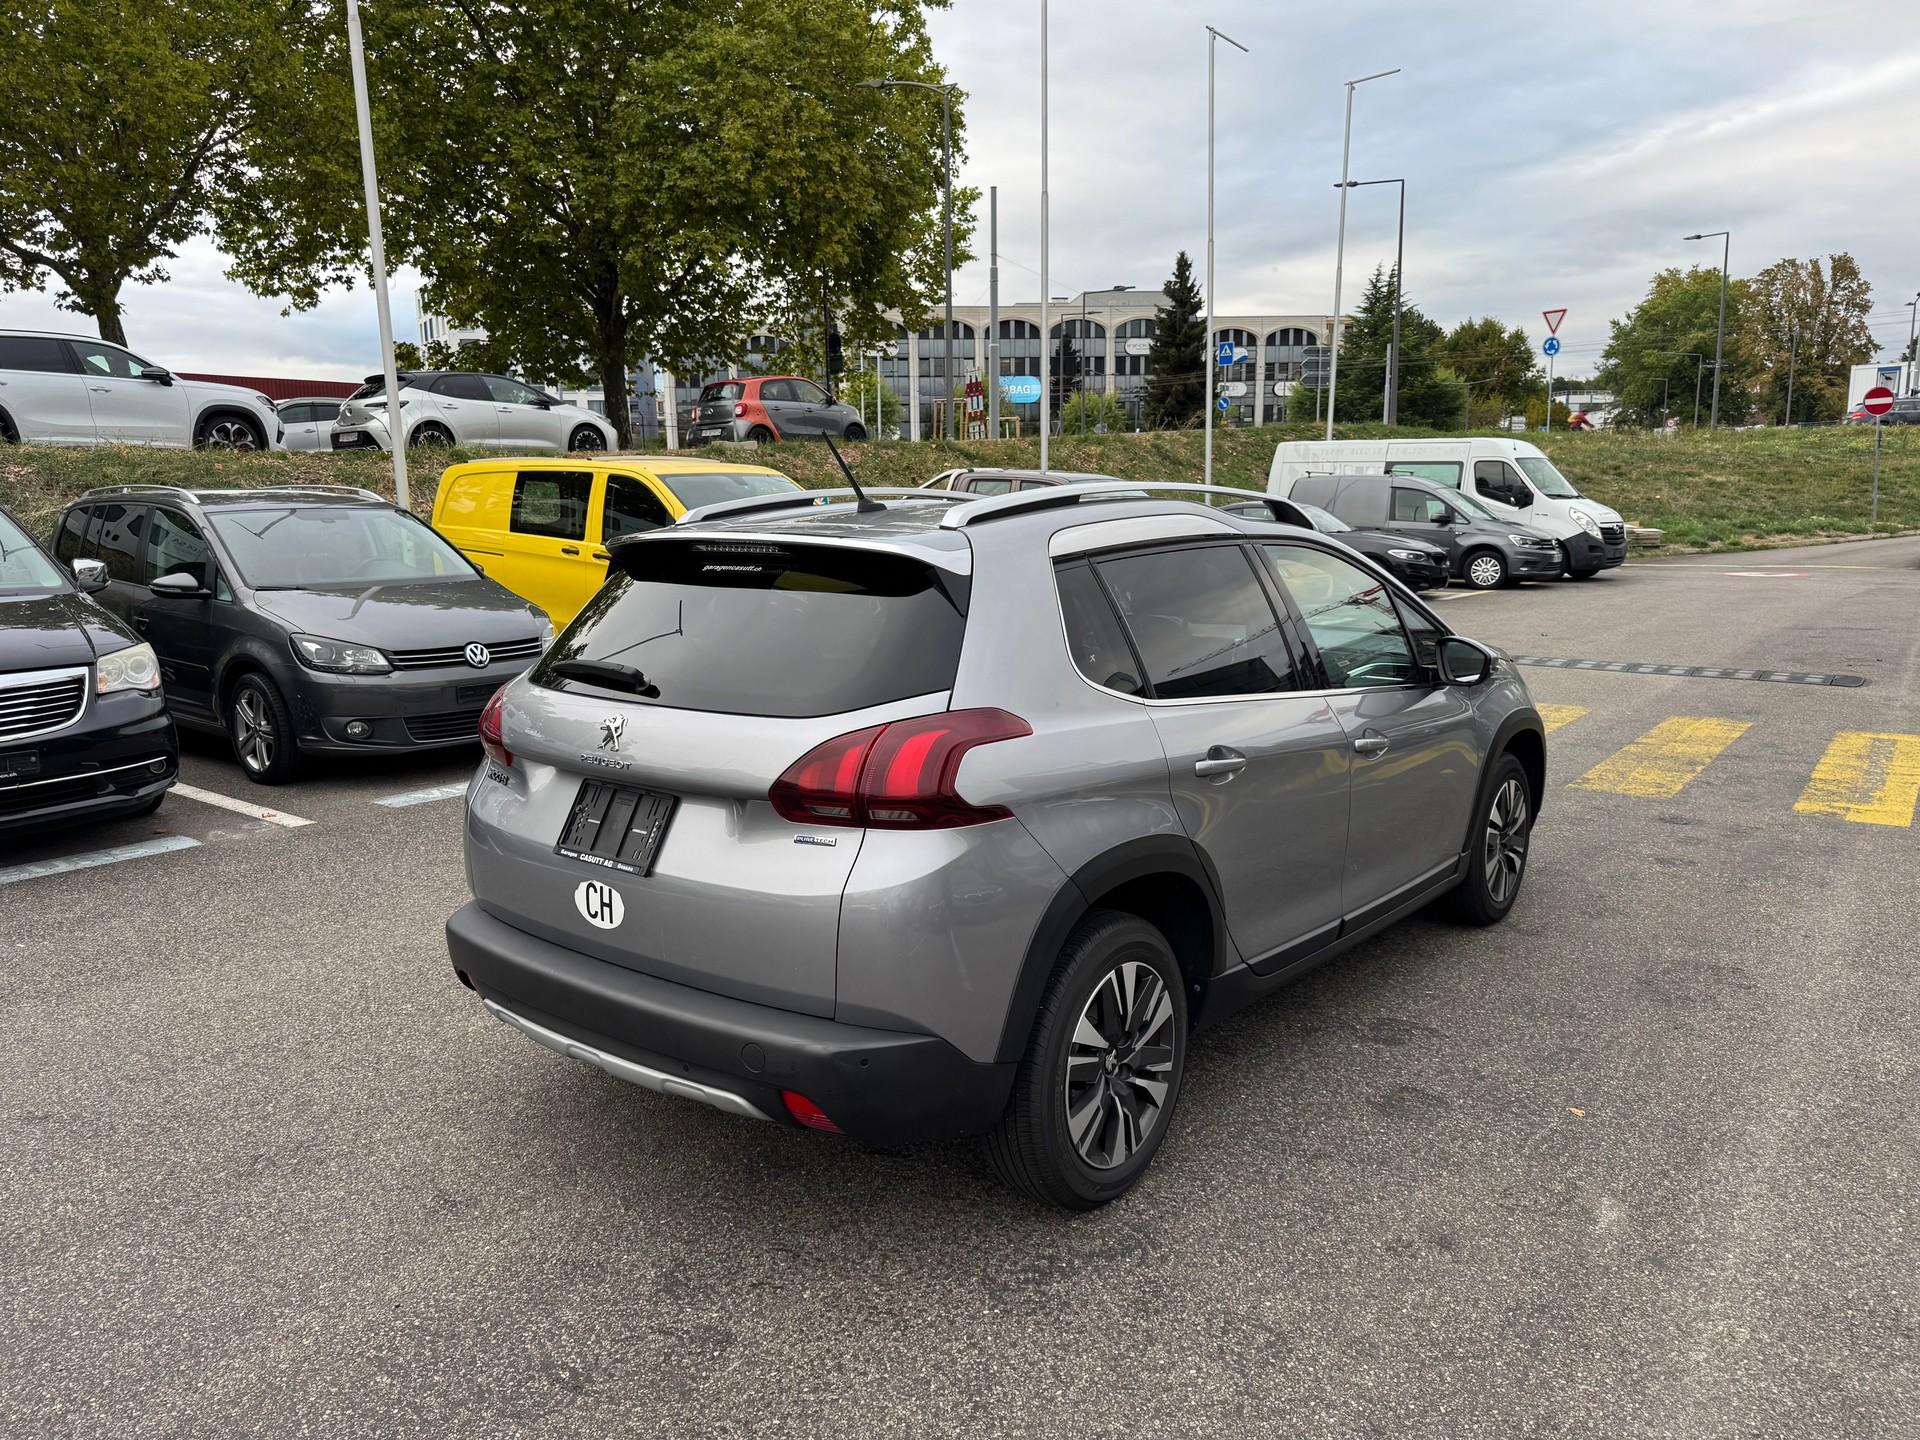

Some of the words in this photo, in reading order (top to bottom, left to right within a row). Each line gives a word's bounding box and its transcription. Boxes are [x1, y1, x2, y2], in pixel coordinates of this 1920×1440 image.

[702, 564, 763, 572] garagencasutt.ch
[580, 753, 632, 771] PEUGEOT
[580, 853, 604, 866] CASUTT
[603, 859, 615, 868] AG
[585, 882, 614, 924] CH
